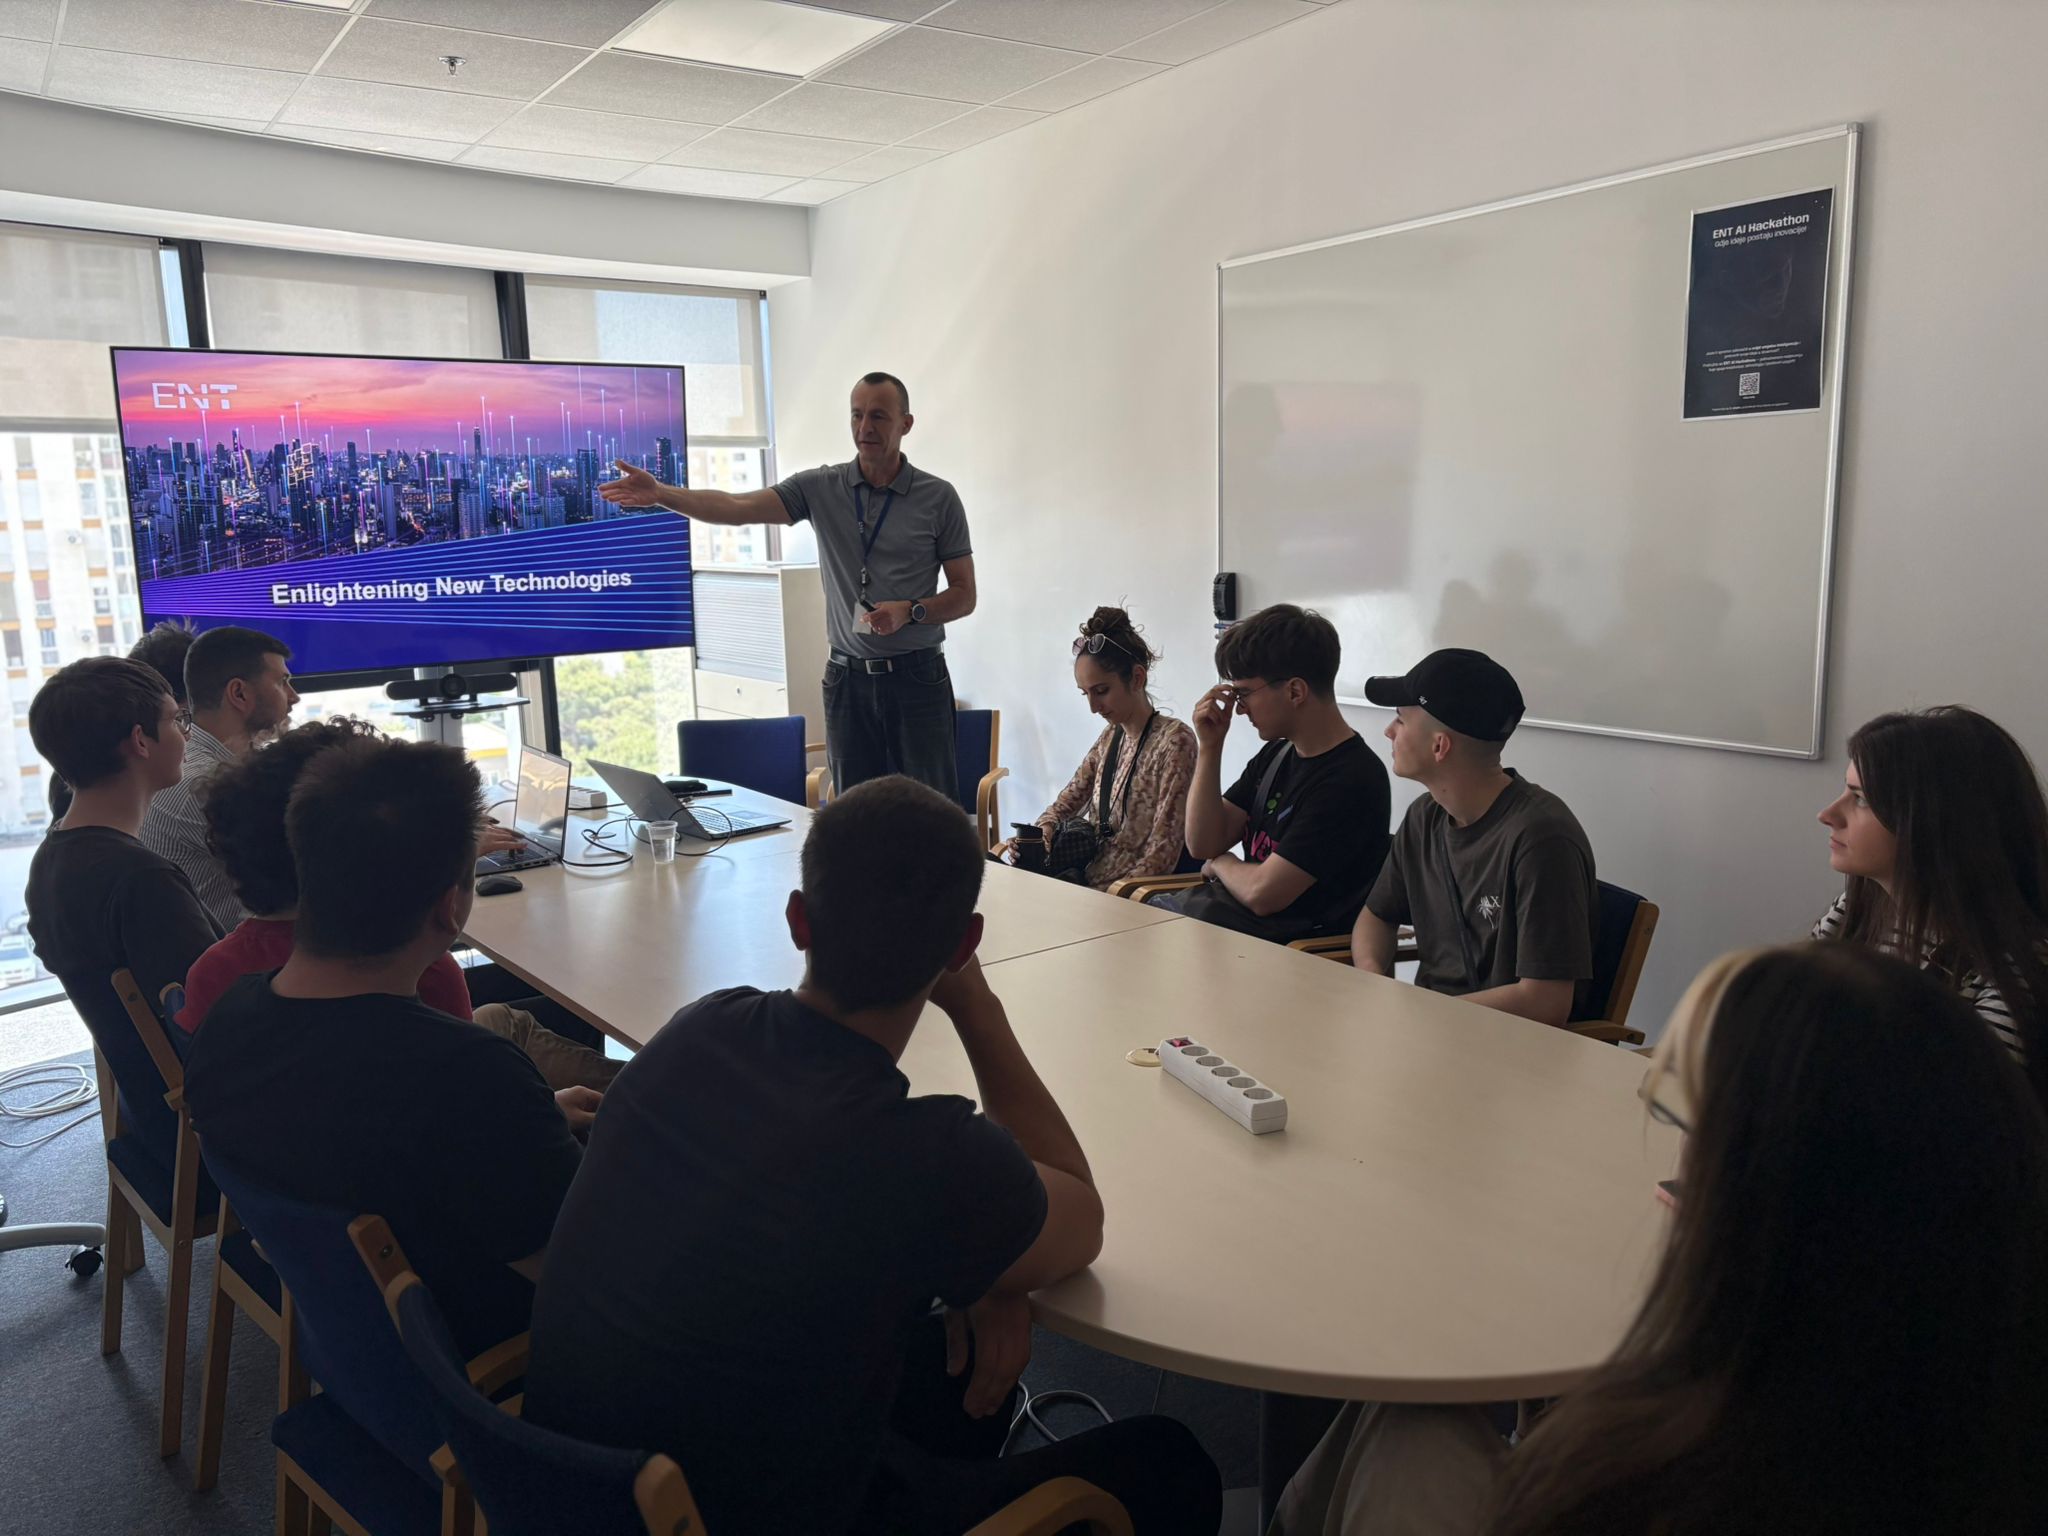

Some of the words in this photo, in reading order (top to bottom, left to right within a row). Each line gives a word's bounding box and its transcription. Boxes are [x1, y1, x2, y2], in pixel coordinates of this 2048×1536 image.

[1712, 226, 1734, 239] ENT
[1735, 224, 1747, 236] AI
[1748, 214, 1810, 233] Hackathon
[151, 382, 238, 410] ENT
[271, 578, 429, 607] Enlightening
[435, 575, 485, 596] New
[489, 568, 632, 593] Technologies
